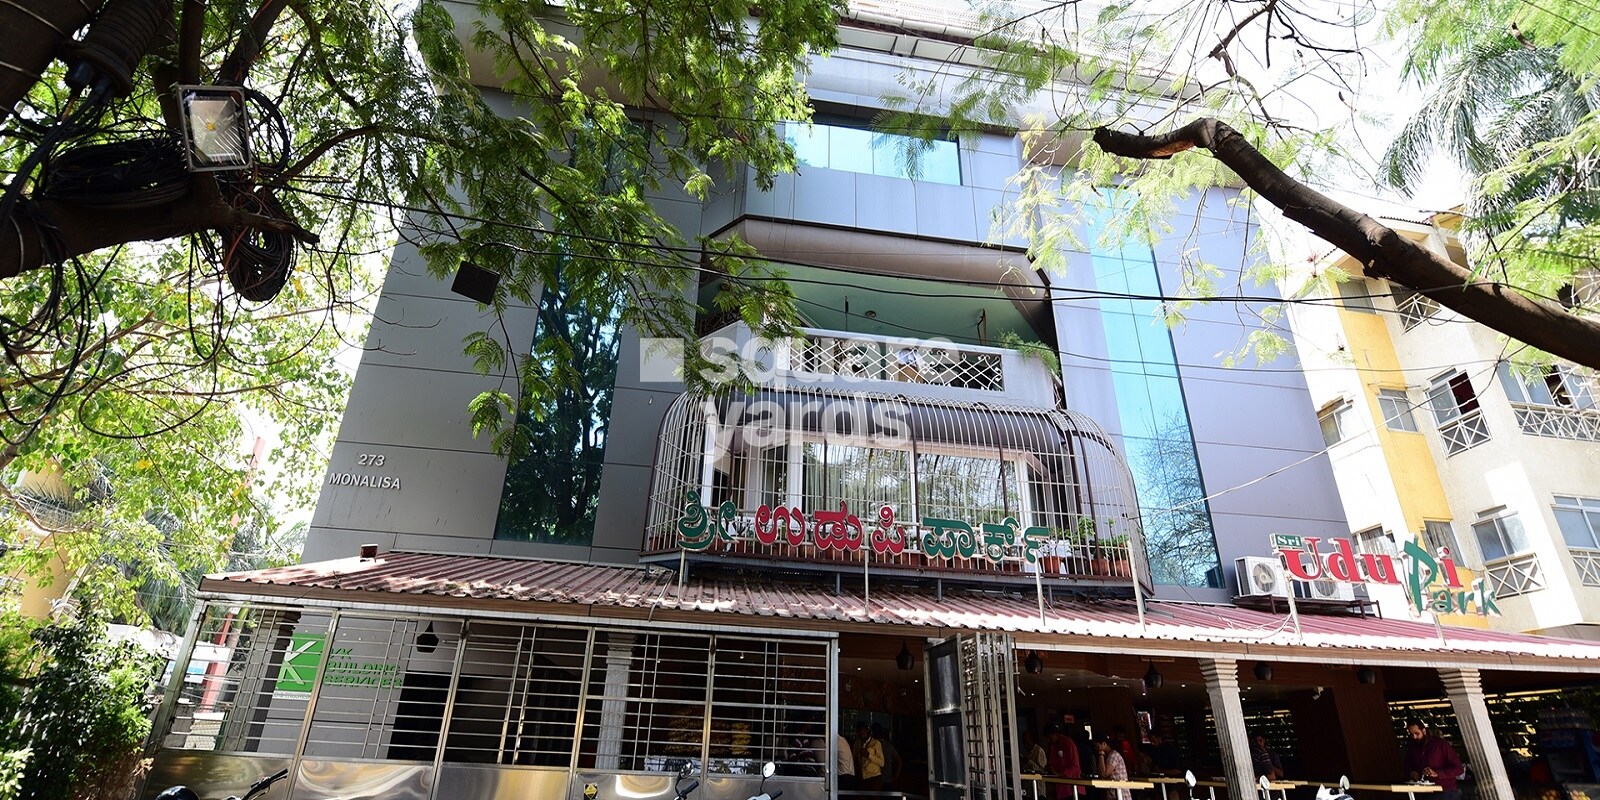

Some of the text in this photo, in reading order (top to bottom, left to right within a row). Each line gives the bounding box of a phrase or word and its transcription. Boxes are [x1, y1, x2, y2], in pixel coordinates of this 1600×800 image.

[358, 453, 385, 467] 273
[328, 472, 401, 490] MONALISA
[677, 490, 1052, 565] ಶ್ರೀ ಉಡುಪಿ ಪಾರ್ಕ್
[1277, 534, 1301, 547] Sri
[326, 661, 401, 676] BUILDING
[324, 674, 402, 689] SERVICES
